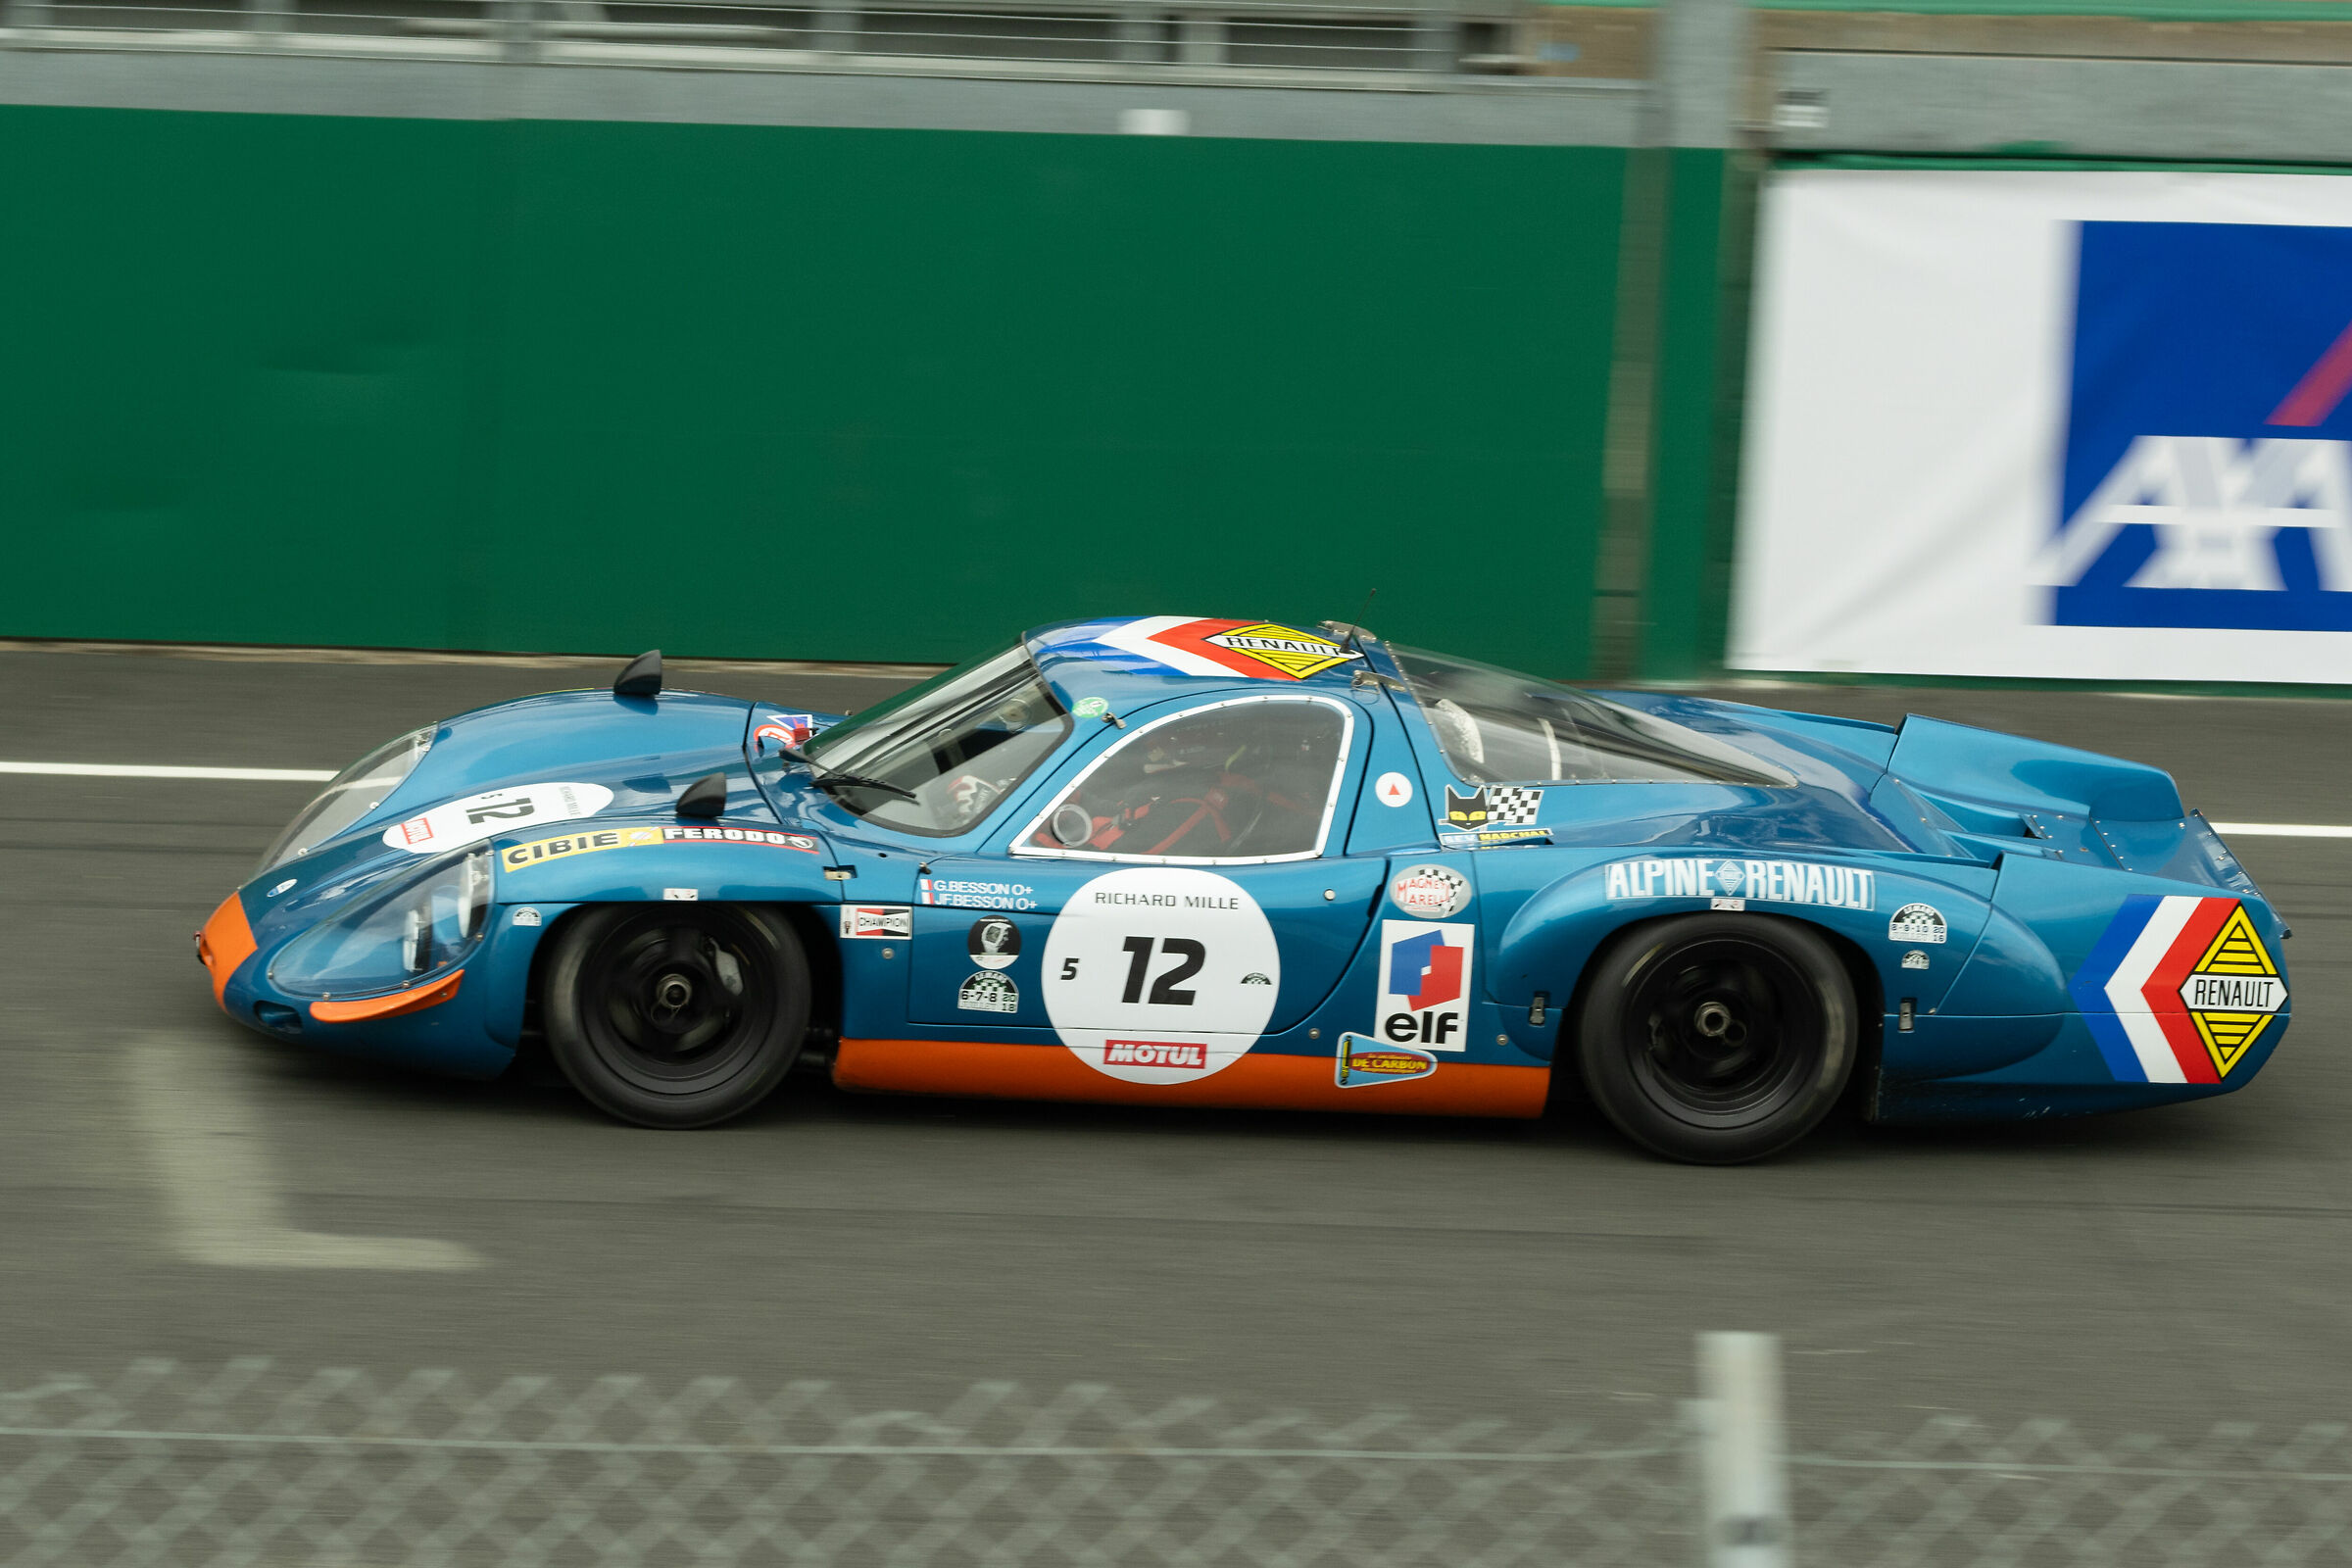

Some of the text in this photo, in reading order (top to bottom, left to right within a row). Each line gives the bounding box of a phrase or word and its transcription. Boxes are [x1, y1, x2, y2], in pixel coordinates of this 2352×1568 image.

[2021, 434, 2352, 593] AXA
[466, 797, 535, 824] 12
[507, 831, 620, 864] CIBIE
[664, 828, 787, 844] FERODO
[933, 880, 1009, 896] G.BESSON
[1607, 859, 1874, 908] ALPINE RENAULT
[1095, 892, 1239, 909] RICHARD MILLE
[858, 916, 908, 928] CHAMPION
[1060, 957, 1080, 980] 5
[1121, 936, 1206, 1005] 12
[961, 990, 998, 1003] 6-7-8
[2194, 979, 2274, 1007] RENAULT
[1385, 1010, 1459, 1045] elf
[1106, 1043, 1203, 1066] MOTUL
[1351, 1057, 1428, 1070] DE CARBON
